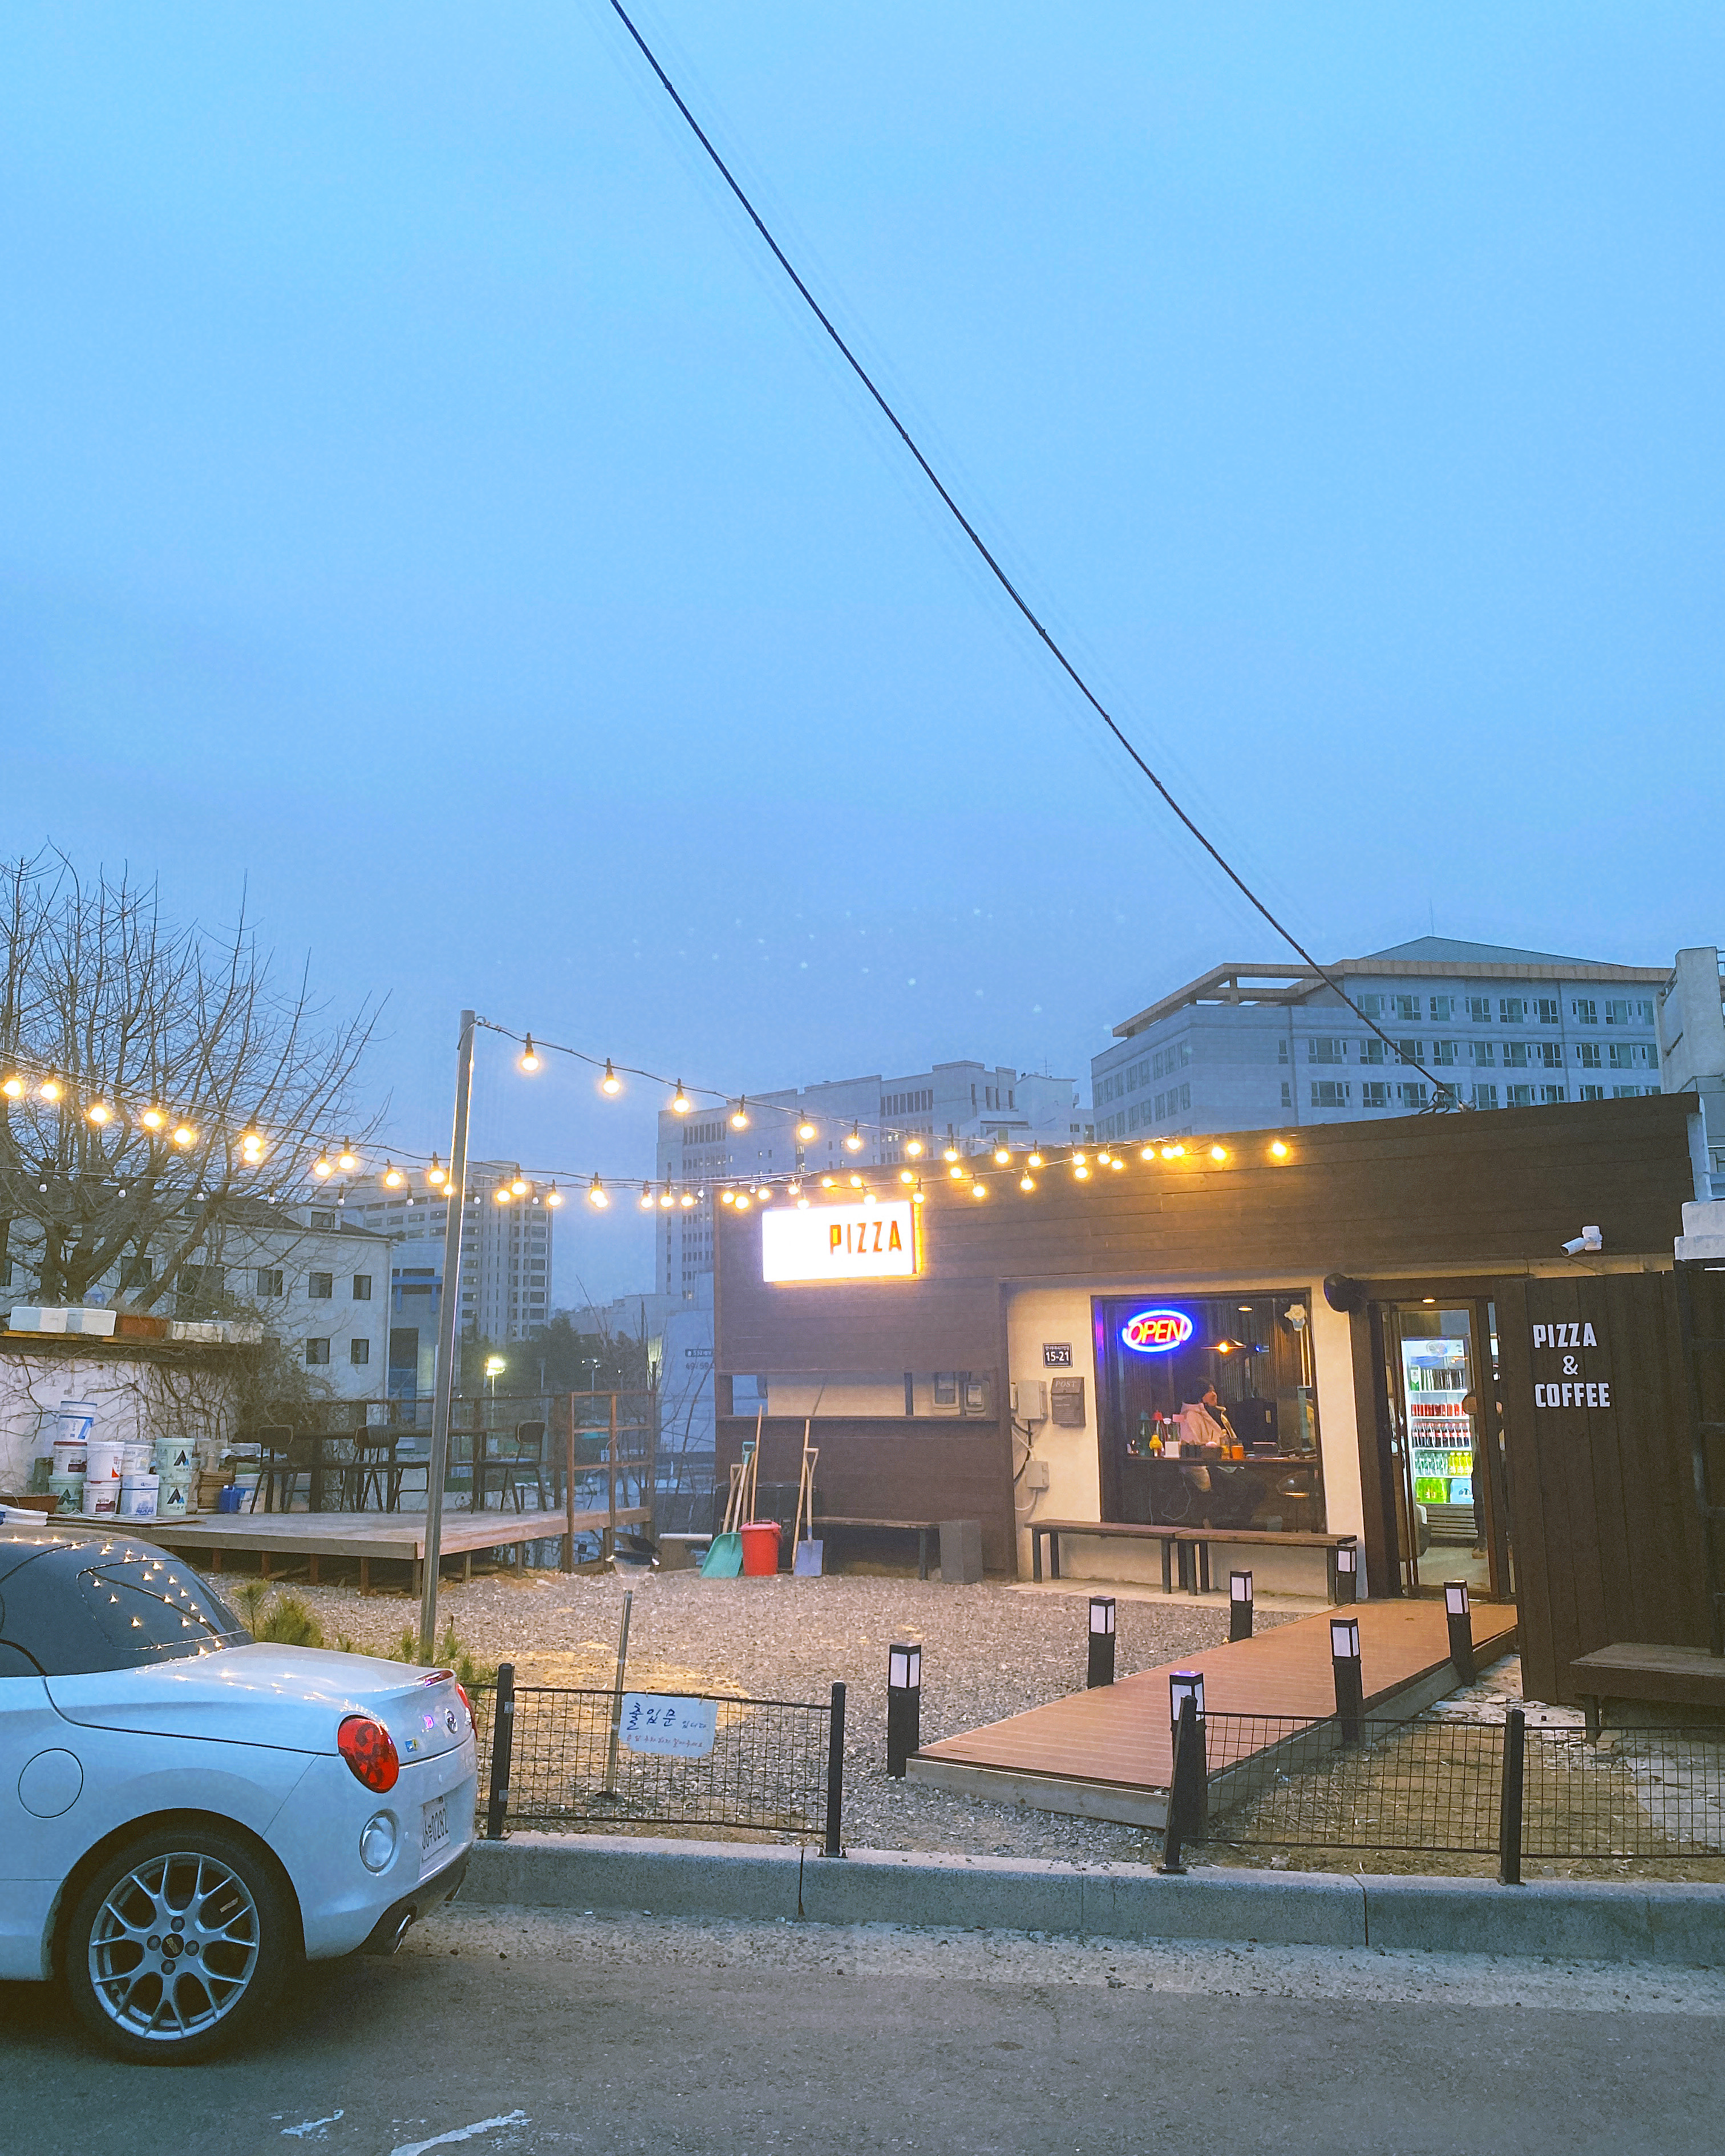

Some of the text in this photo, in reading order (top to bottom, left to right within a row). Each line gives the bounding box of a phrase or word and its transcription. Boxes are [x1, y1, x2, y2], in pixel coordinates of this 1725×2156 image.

[829, 1221, 902, 1255] PIZZA
[1127, 1319, 1185, 1344] OPEN
[1533, 1323, 1598, 1348] PIZZA
[1046, 1351, 1069, 1361] 15-21
[1562, 1355, 1578, 1375] &
[1055, 1379, 1077, 1388] POST
[1534, 1383, 1610, 1408] COFFEE
[626, 1703, 677, 1731] 출입문
